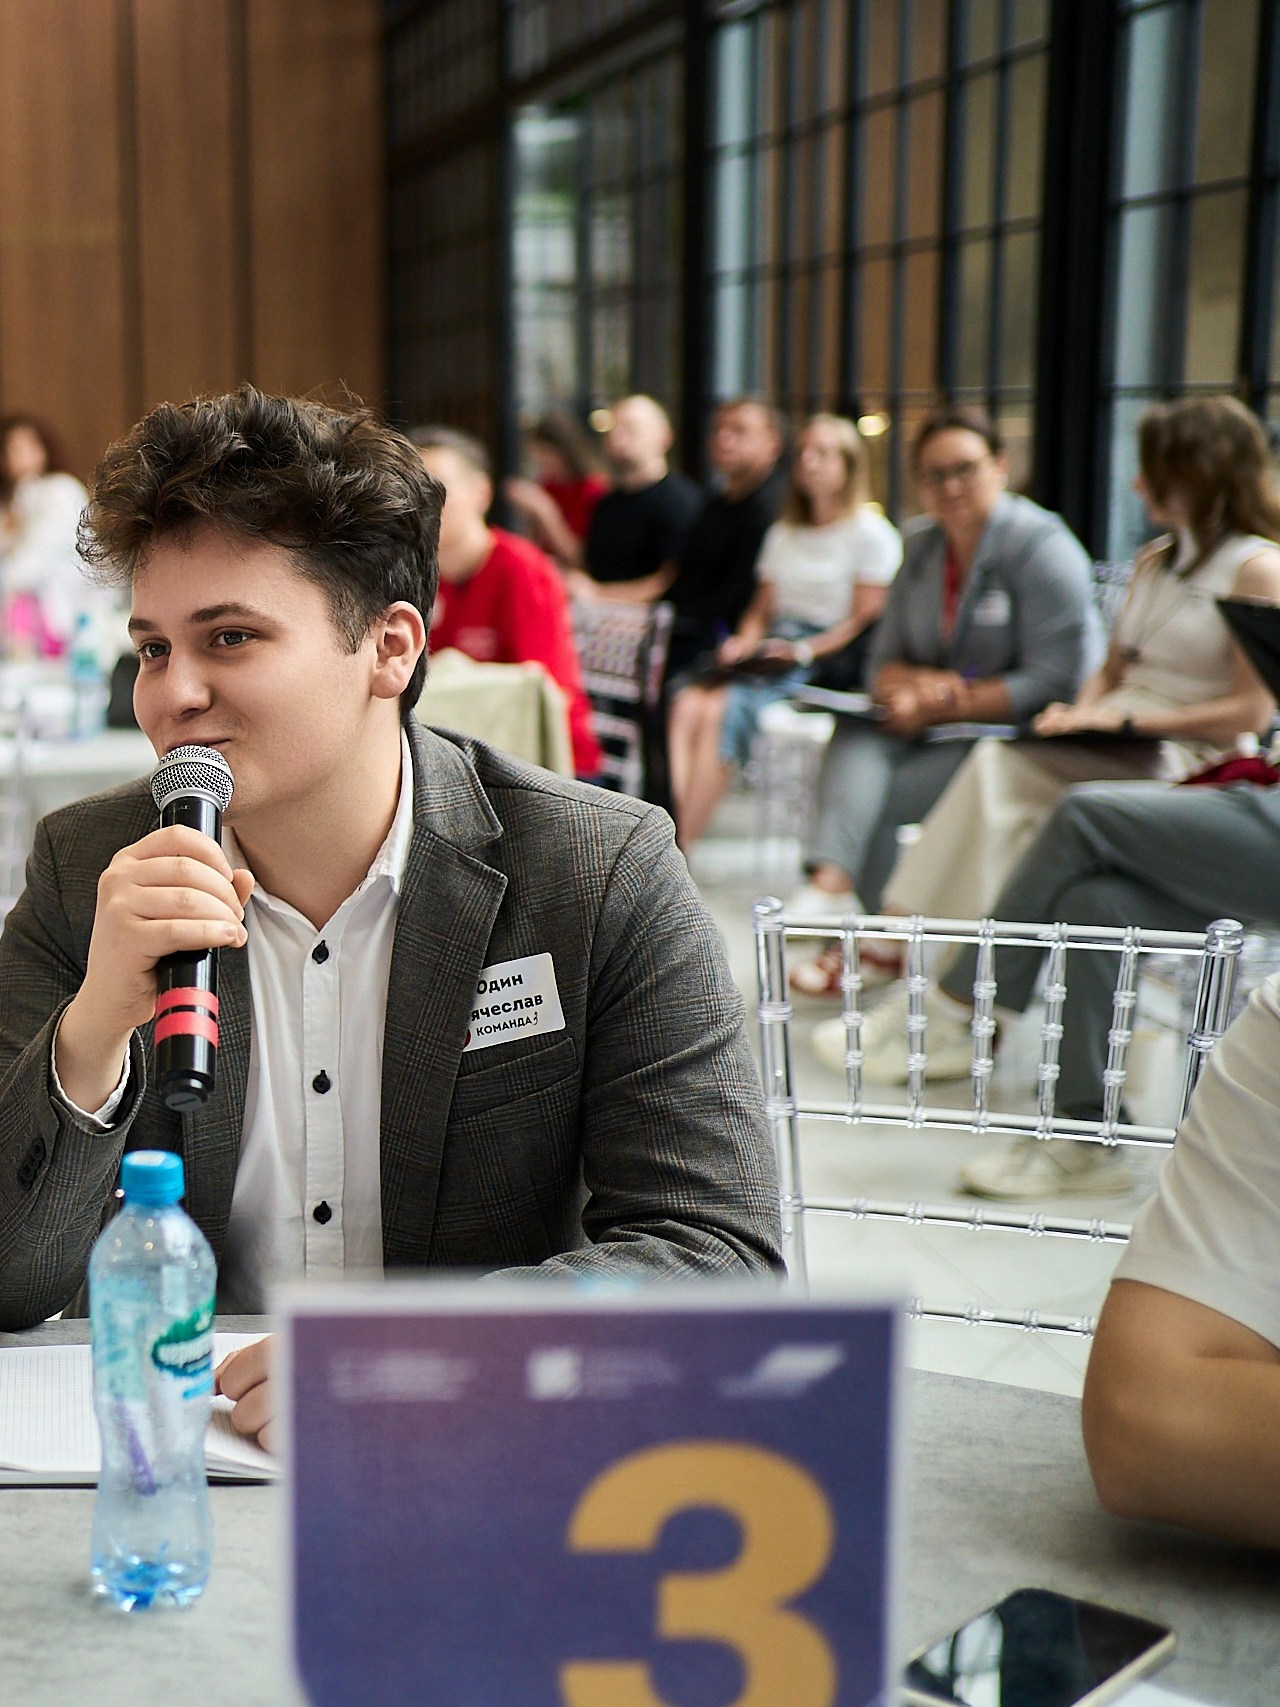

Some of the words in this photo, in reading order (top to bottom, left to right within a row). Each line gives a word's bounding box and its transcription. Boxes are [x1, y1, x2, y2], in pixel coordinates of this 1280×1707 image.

[471, 994, 544, 1022] ячеслав
[476, 1015, 532, 1036] КОМАНДА
[559, 1437, 838, 1707] 3
